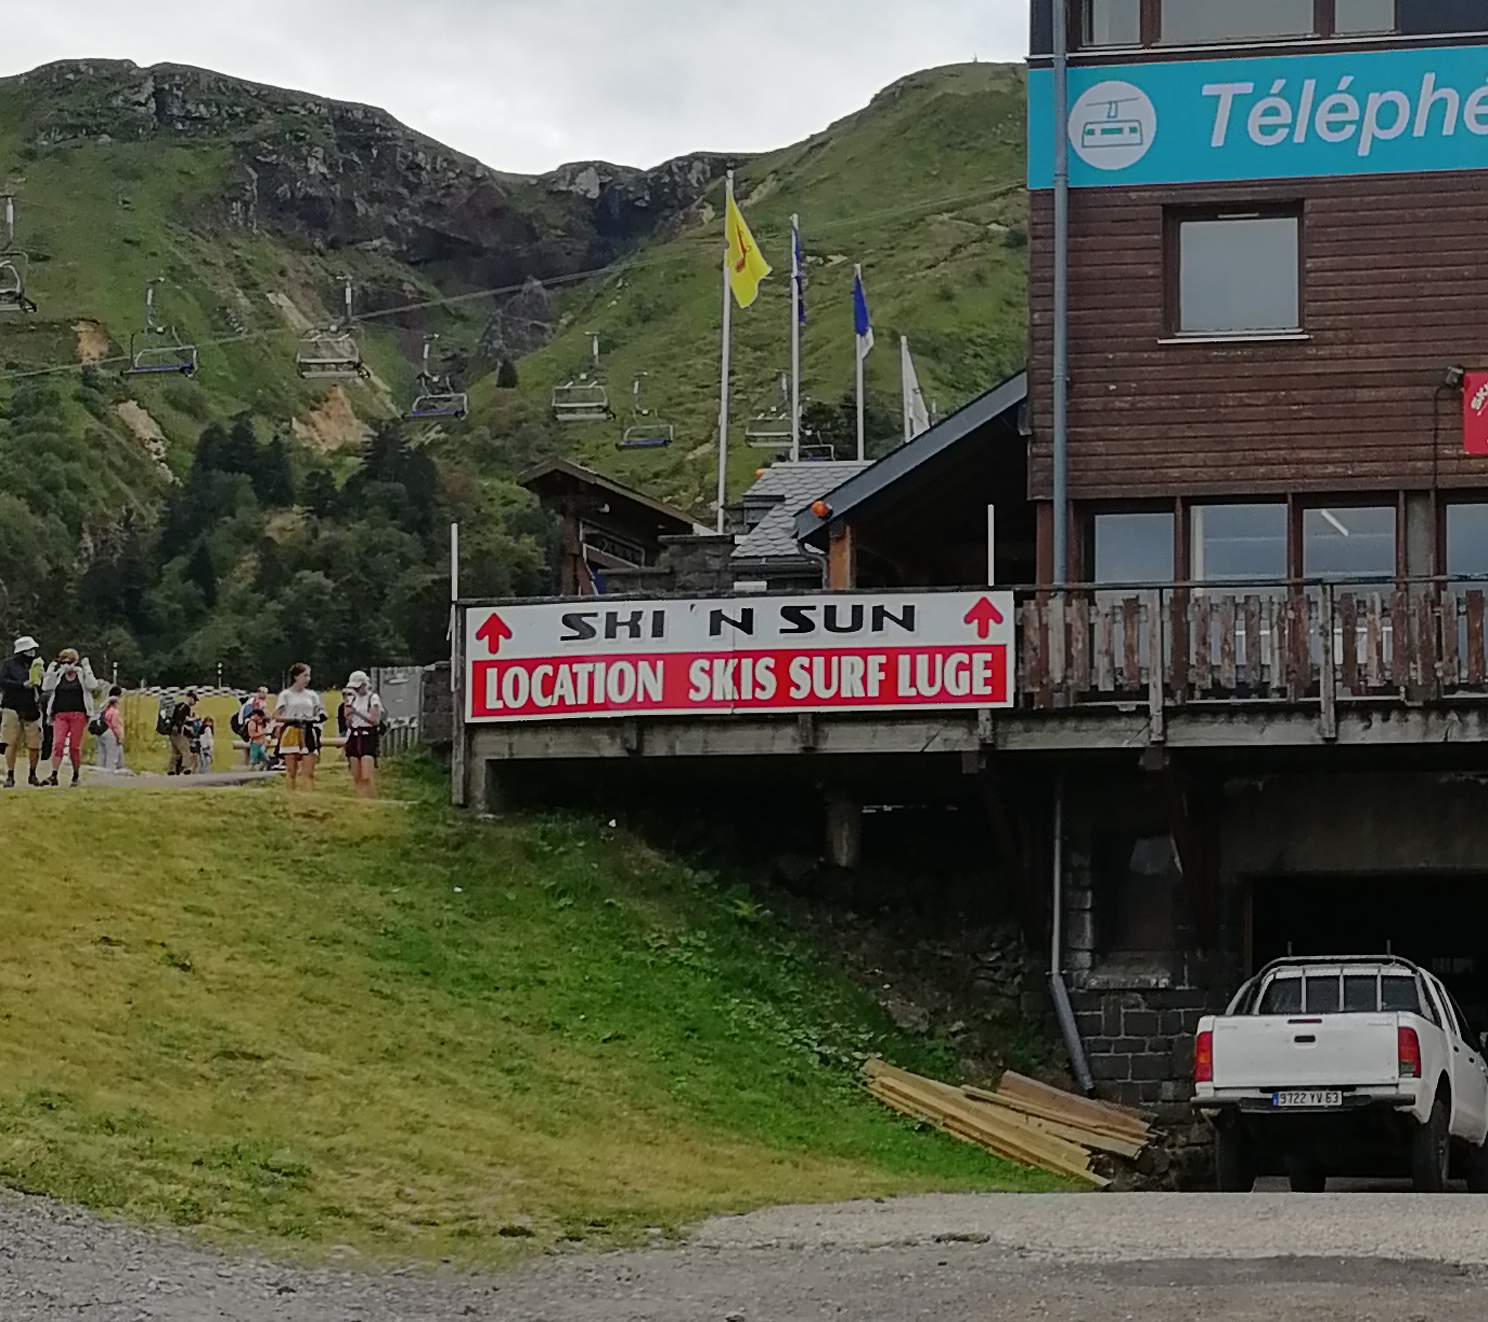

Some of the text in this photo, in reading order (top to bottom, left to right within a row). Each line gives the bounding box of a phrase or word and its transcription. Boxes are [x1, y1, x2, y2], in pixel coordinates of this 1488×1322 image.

[560, 610, 665, 641] SKI
[780, 604, 916, 635] SUN
[485, 651, 993, 710] LOCATION SKIS SURF LUGE
[1280, 1092, 1307, 1104] 9722
[1325, 1092, 1339, 1104] 63
